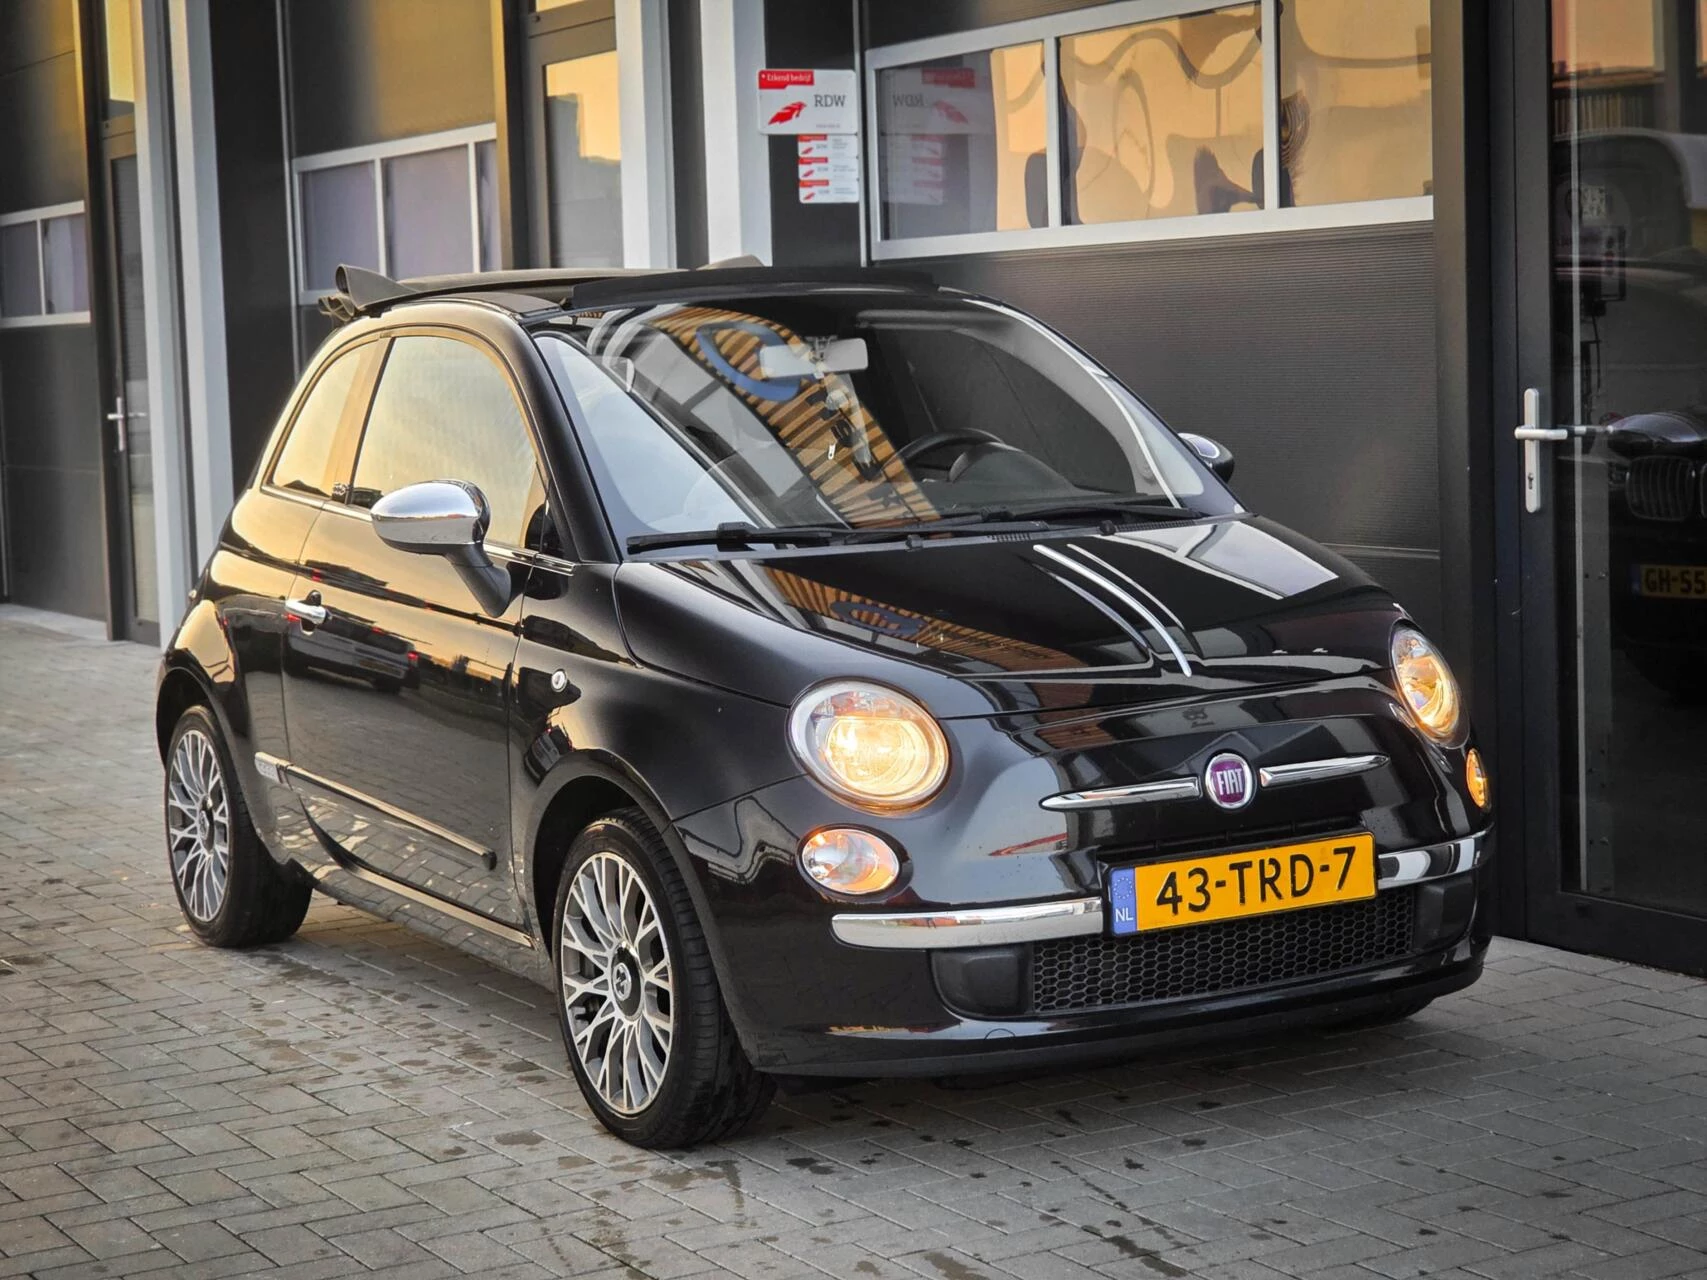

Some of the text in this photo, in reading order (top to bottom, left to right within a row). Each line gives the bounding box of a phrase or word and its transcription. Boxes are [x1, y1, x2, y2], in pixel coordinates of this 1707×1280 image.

[814, 94, 846, 108] RDW
[1216, 767, 1244, 796] FIAT
[1156, 846, 1357, 916] 43-TRD-7
[1115, 908, 1134, 922] NL
